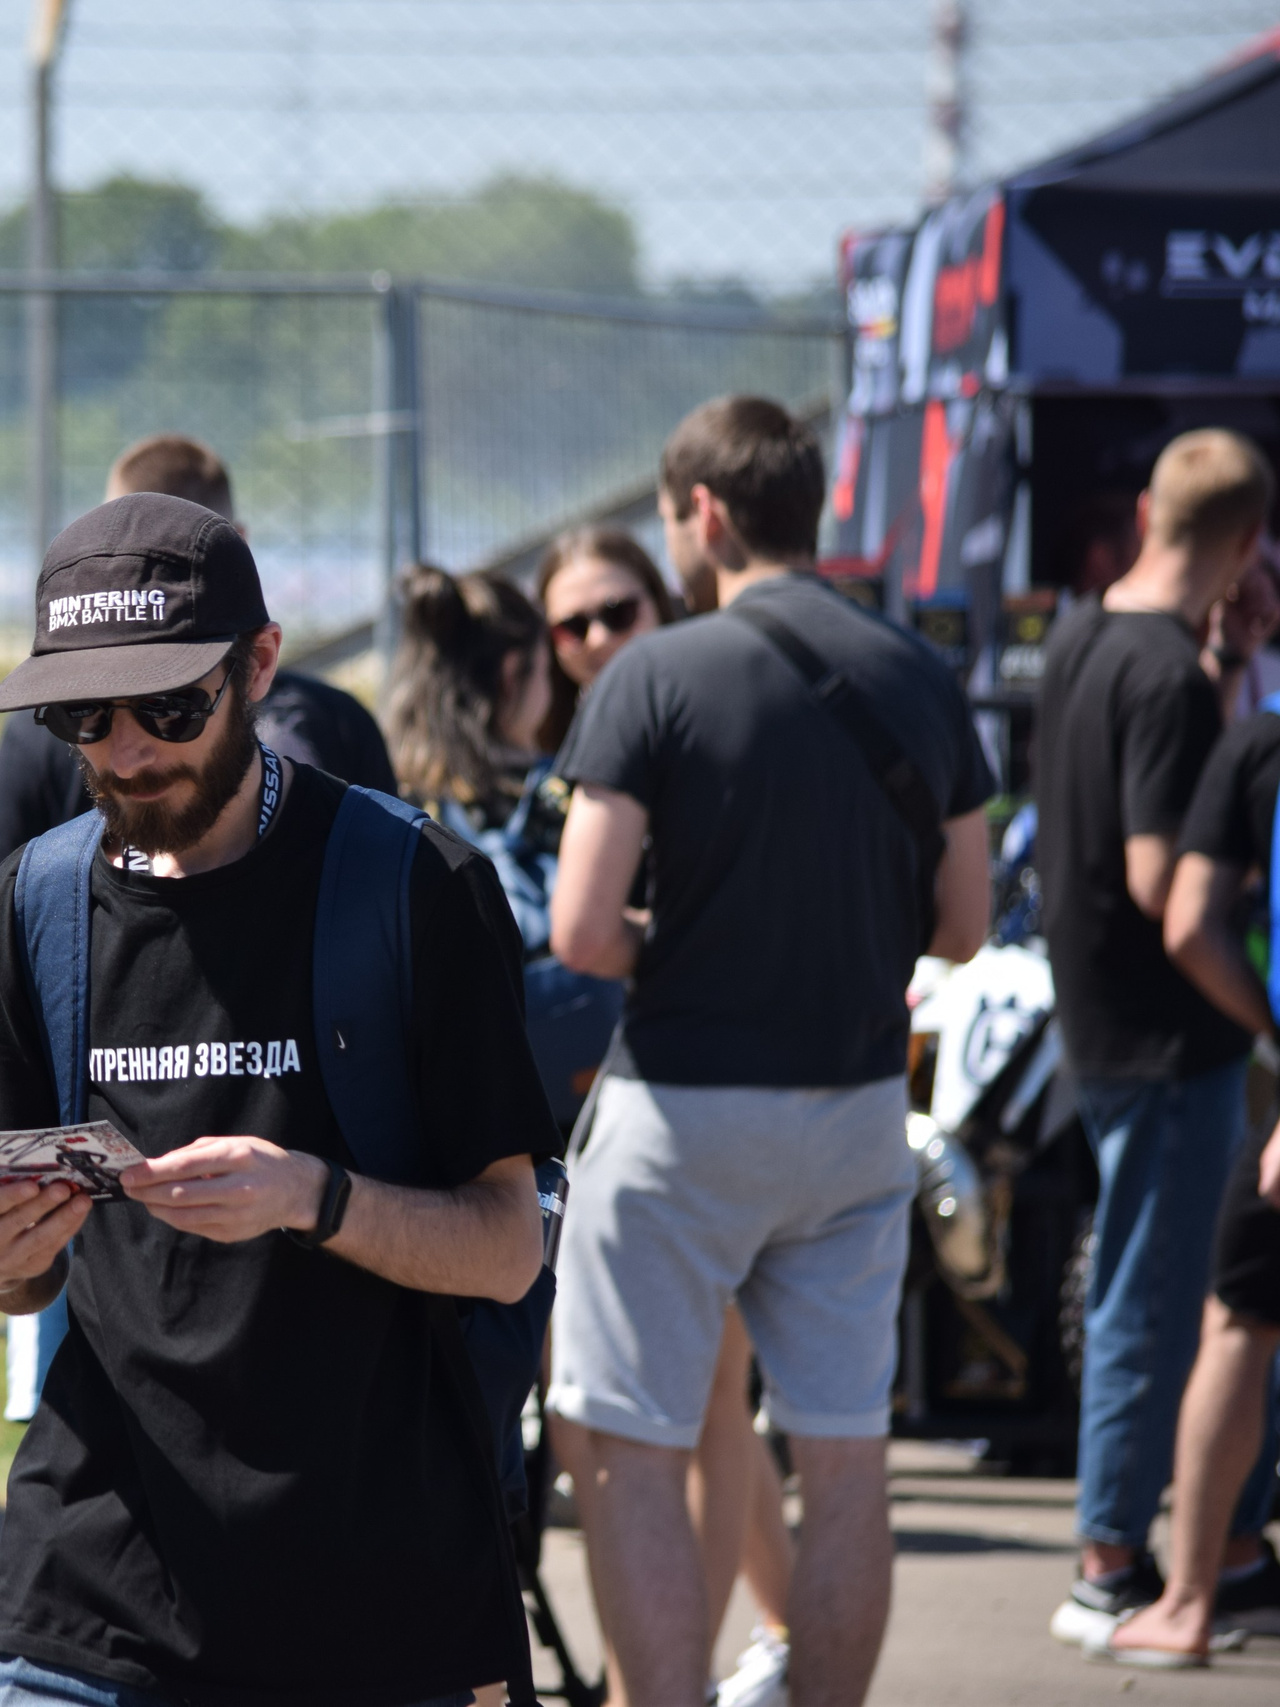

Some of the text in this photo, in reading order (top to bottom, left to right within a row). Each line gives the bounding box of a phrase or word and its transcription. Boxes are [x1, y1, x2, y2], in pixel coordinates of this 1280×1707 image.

[49, 589, 166, 616] WINTERING
[48, 605, 164, 632] BMX BATTLE II
[194, 1039, 301, 1079] ЗВЕЗДА
